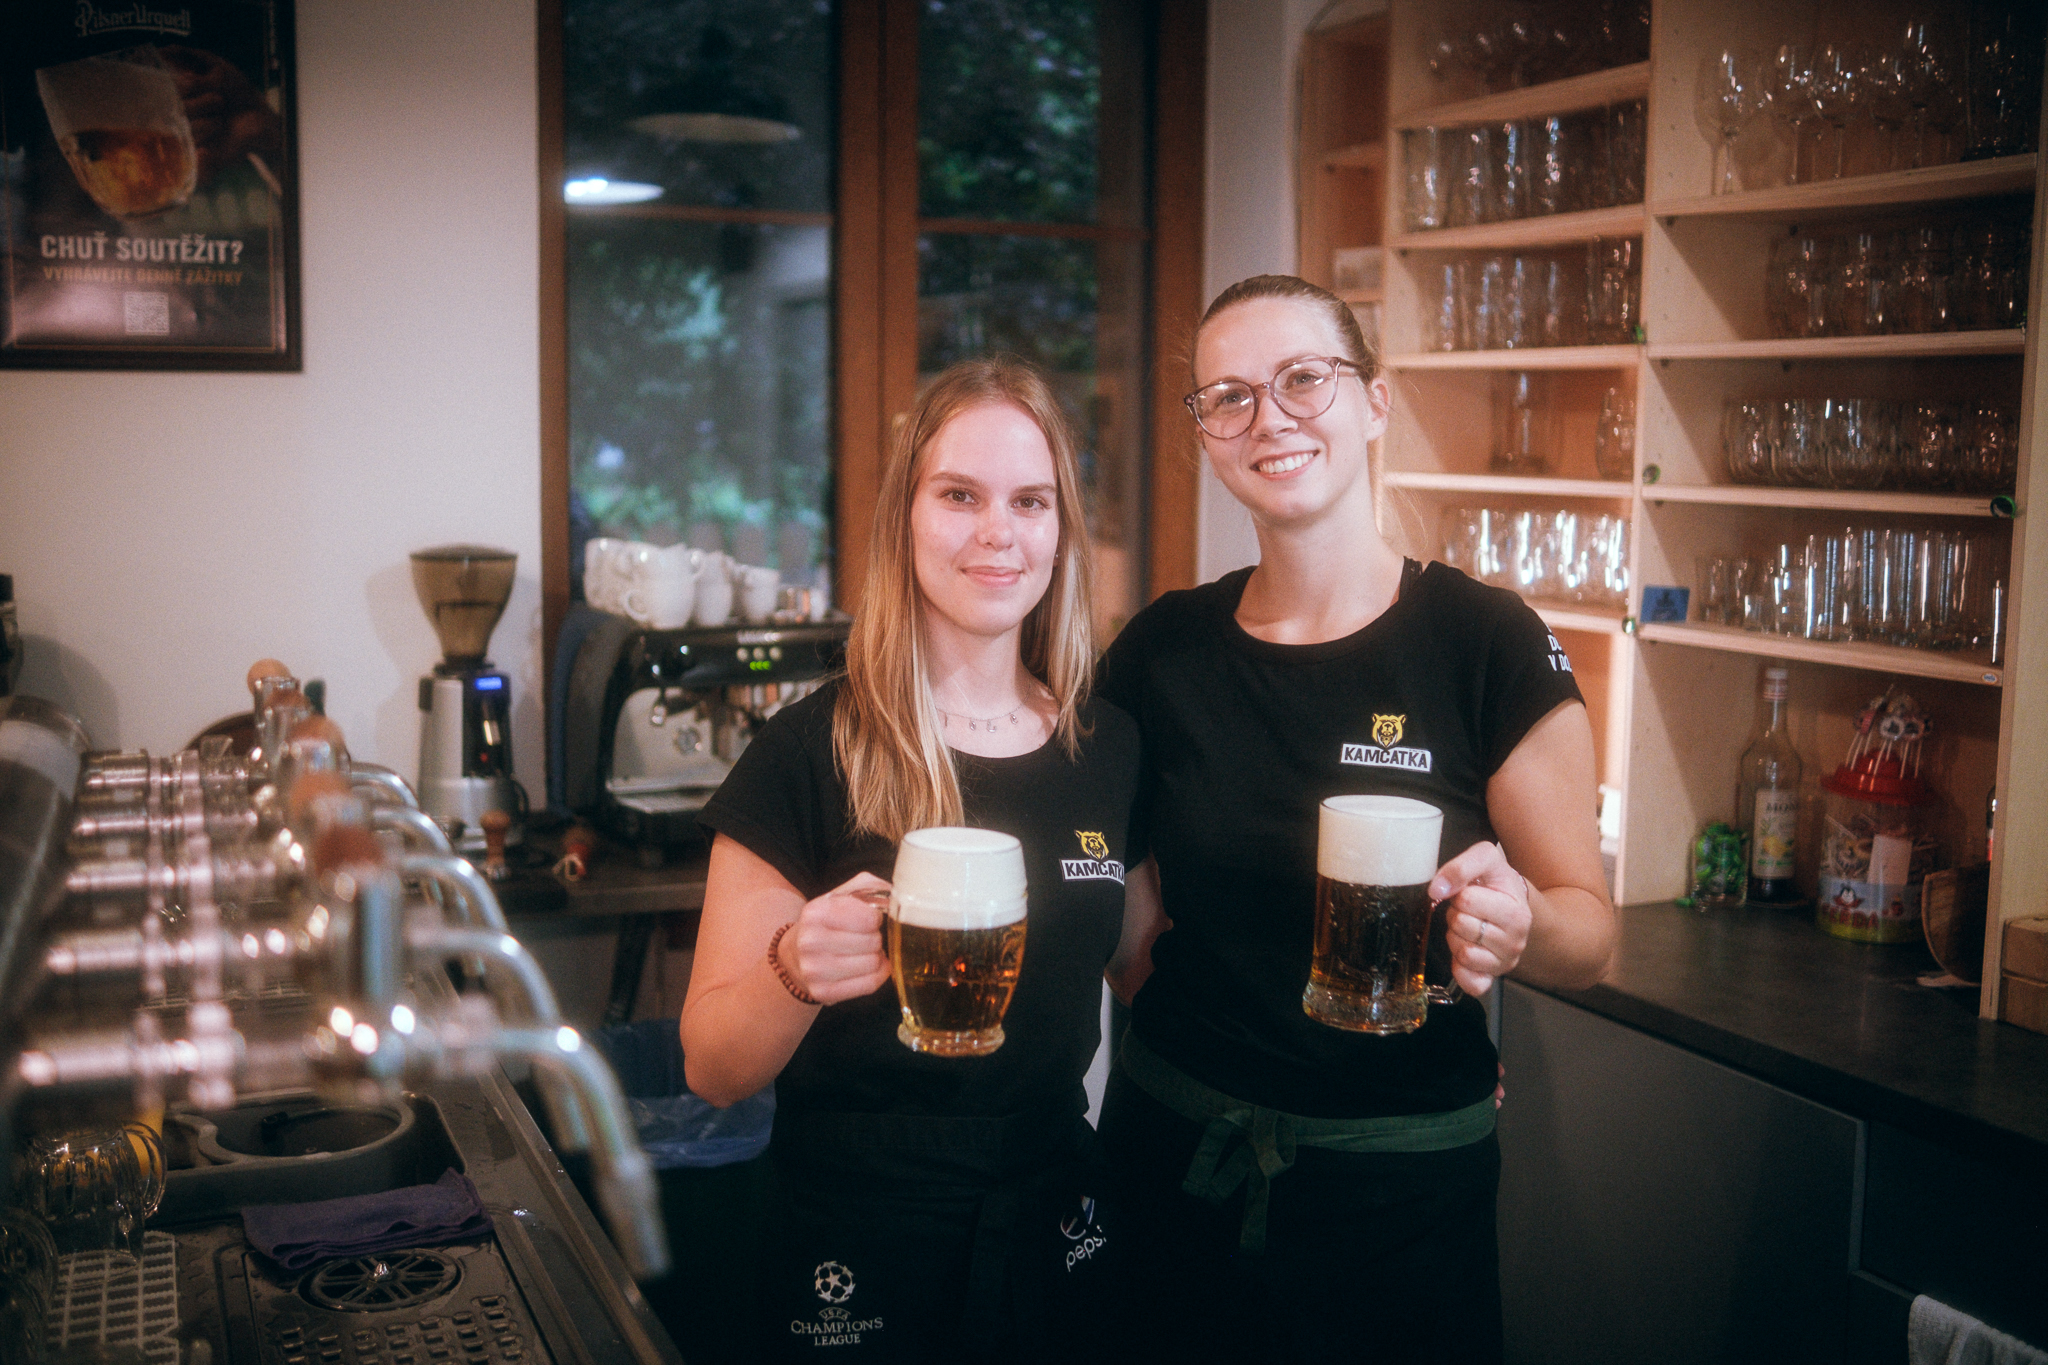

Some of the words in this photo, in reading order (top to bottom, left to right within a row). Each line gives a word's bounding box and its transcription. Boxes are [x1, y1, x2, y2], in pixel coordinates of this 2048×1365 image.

[75, 0, 134, 37] Pilsner
[133, 2, 191, 35] Urquell
[41, 231, 109, 260] CHUŤ
[116, 233, 244, 265] SOUTĚŽIT?
[1547, 654, 1558, 671] V
[821, 1308, 849, 1321] UEFA
[790, 1317, 884, 1334] CHAMPIONS
[814, 1333, 861, 1346] LEAGUE
